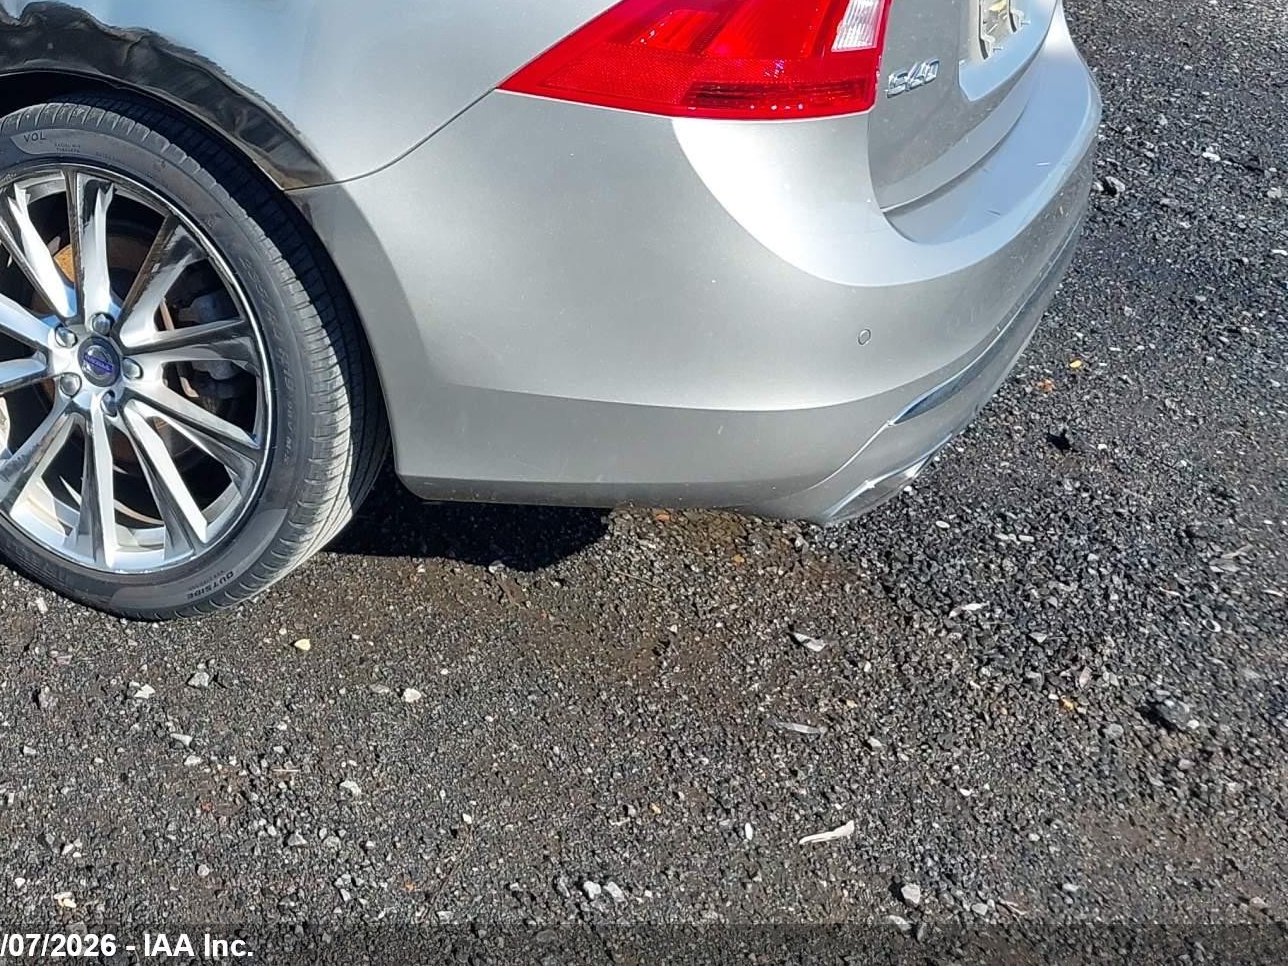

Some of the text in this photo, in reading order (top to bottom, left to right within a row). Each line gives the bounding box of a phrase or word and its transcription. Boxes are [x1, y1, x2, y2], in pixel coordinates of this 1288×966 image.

[885, 59, 940, 99] S60
[23, 133, 47, 143] VOL
[187, 571, 234, 600] OUTSIDE
